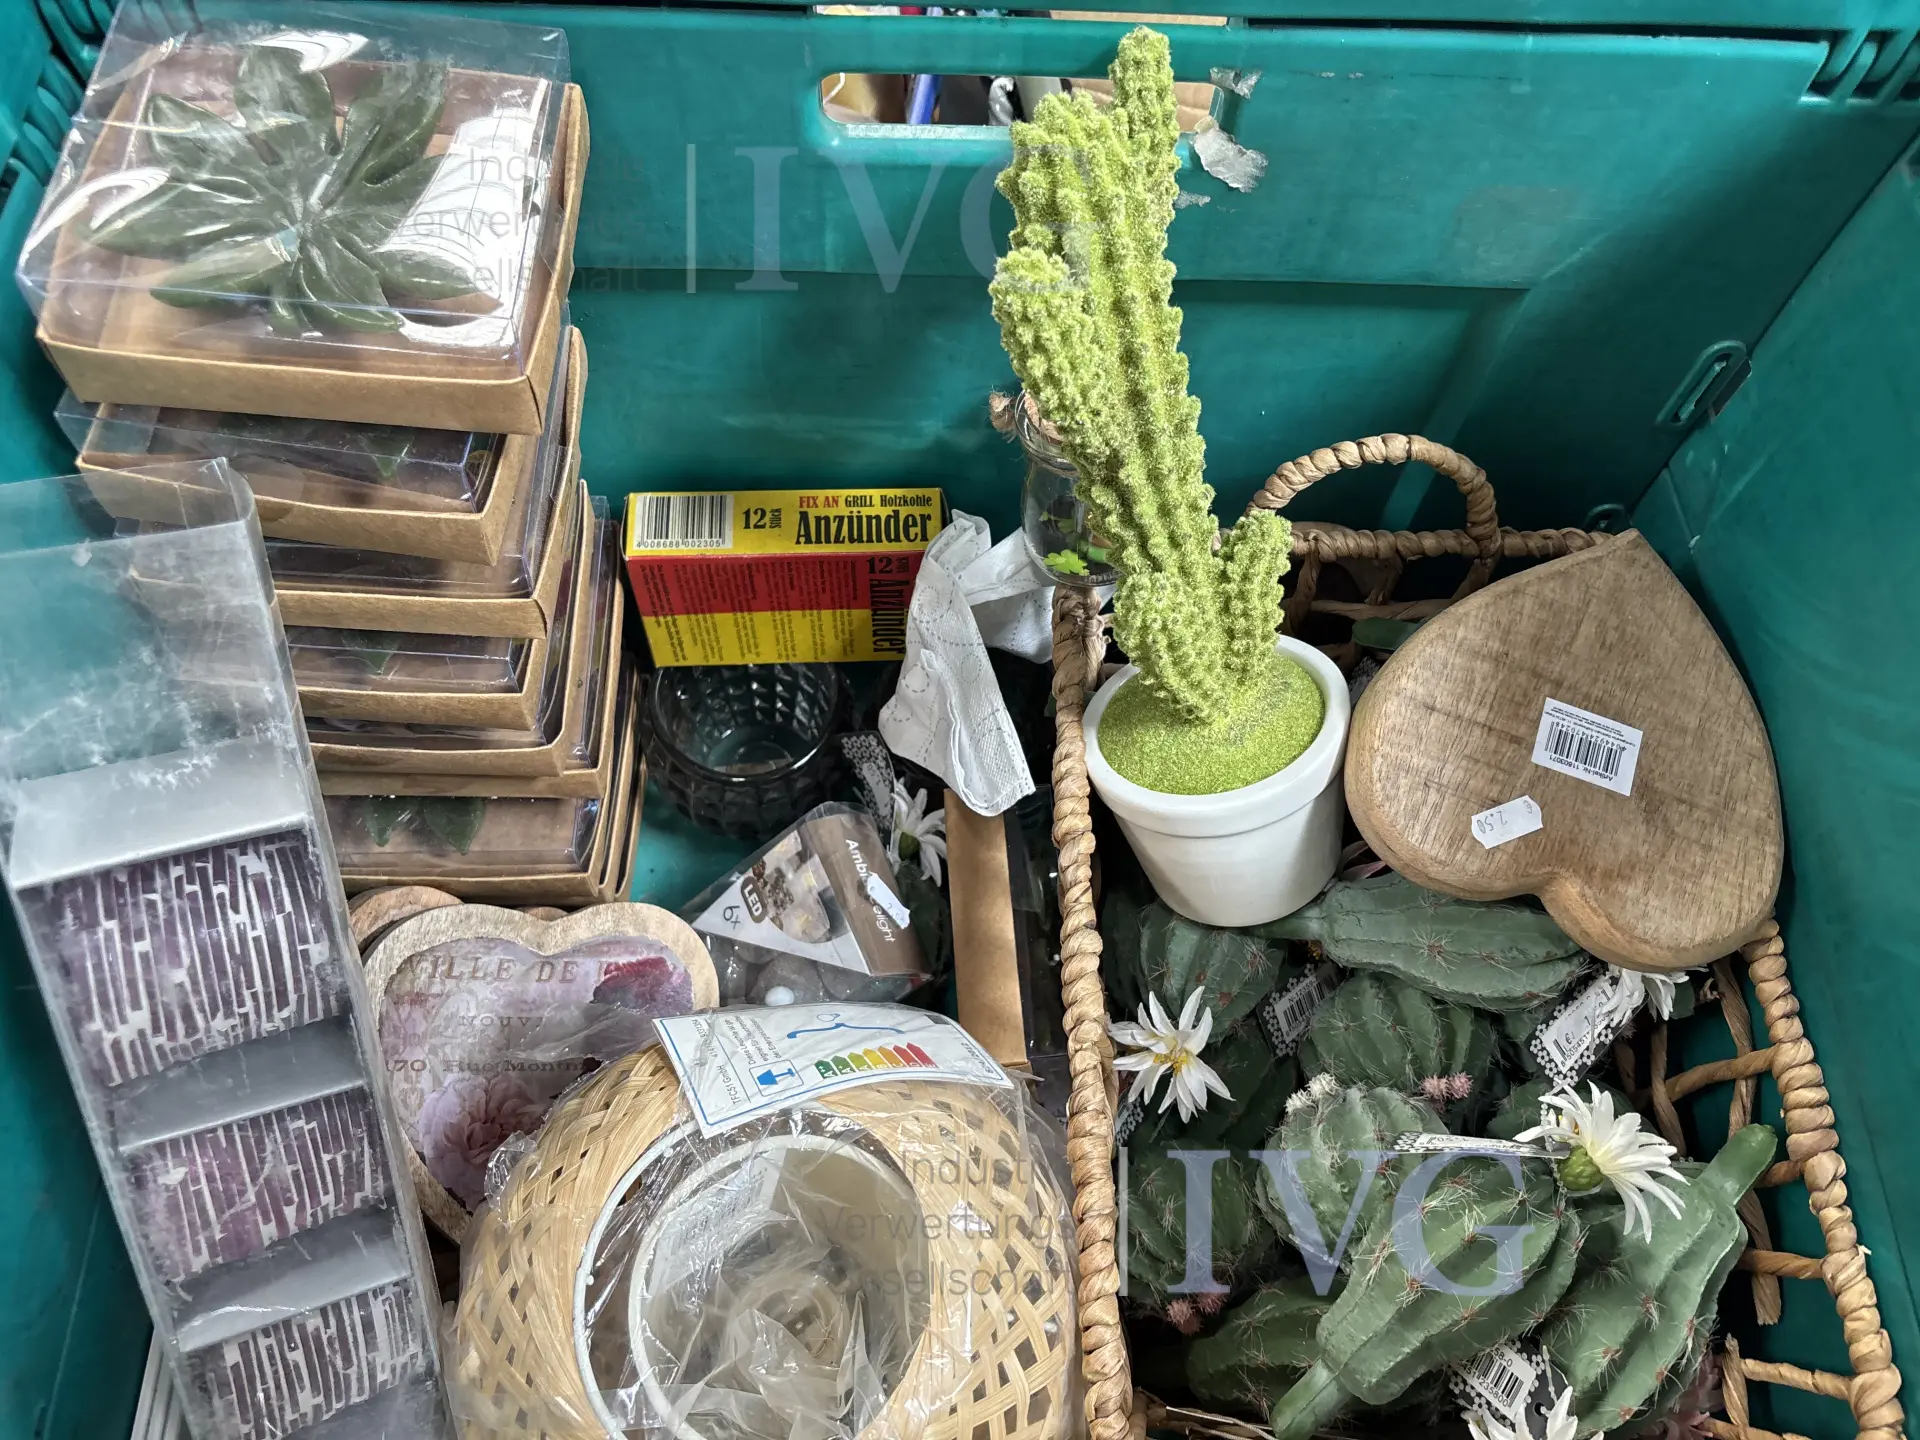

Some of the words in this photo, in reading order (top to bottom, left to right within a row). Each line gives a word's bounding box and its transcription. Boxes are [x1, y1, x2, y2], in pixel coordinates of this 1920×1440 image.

[799, 496, 819, 508] FIX
[823, 495, 839, 508] AN
[845, 495, 875, 508] GRILL
[880, 494, 932, 507] Holzkohle
[742, 507, 767, 530] 12
[795, 510, 931, 545] Anzünder
[866, 556, 893, 574] 12
[869, 578, 910, 655] Anzünder
[743, 883, 763, 917] LED
[845, 839, 896, 943] Ambielight
[723, 905, 741, 929] 6x
[408, 954, 516, 982] VILLE
[536, 960, 580, 984] DE
